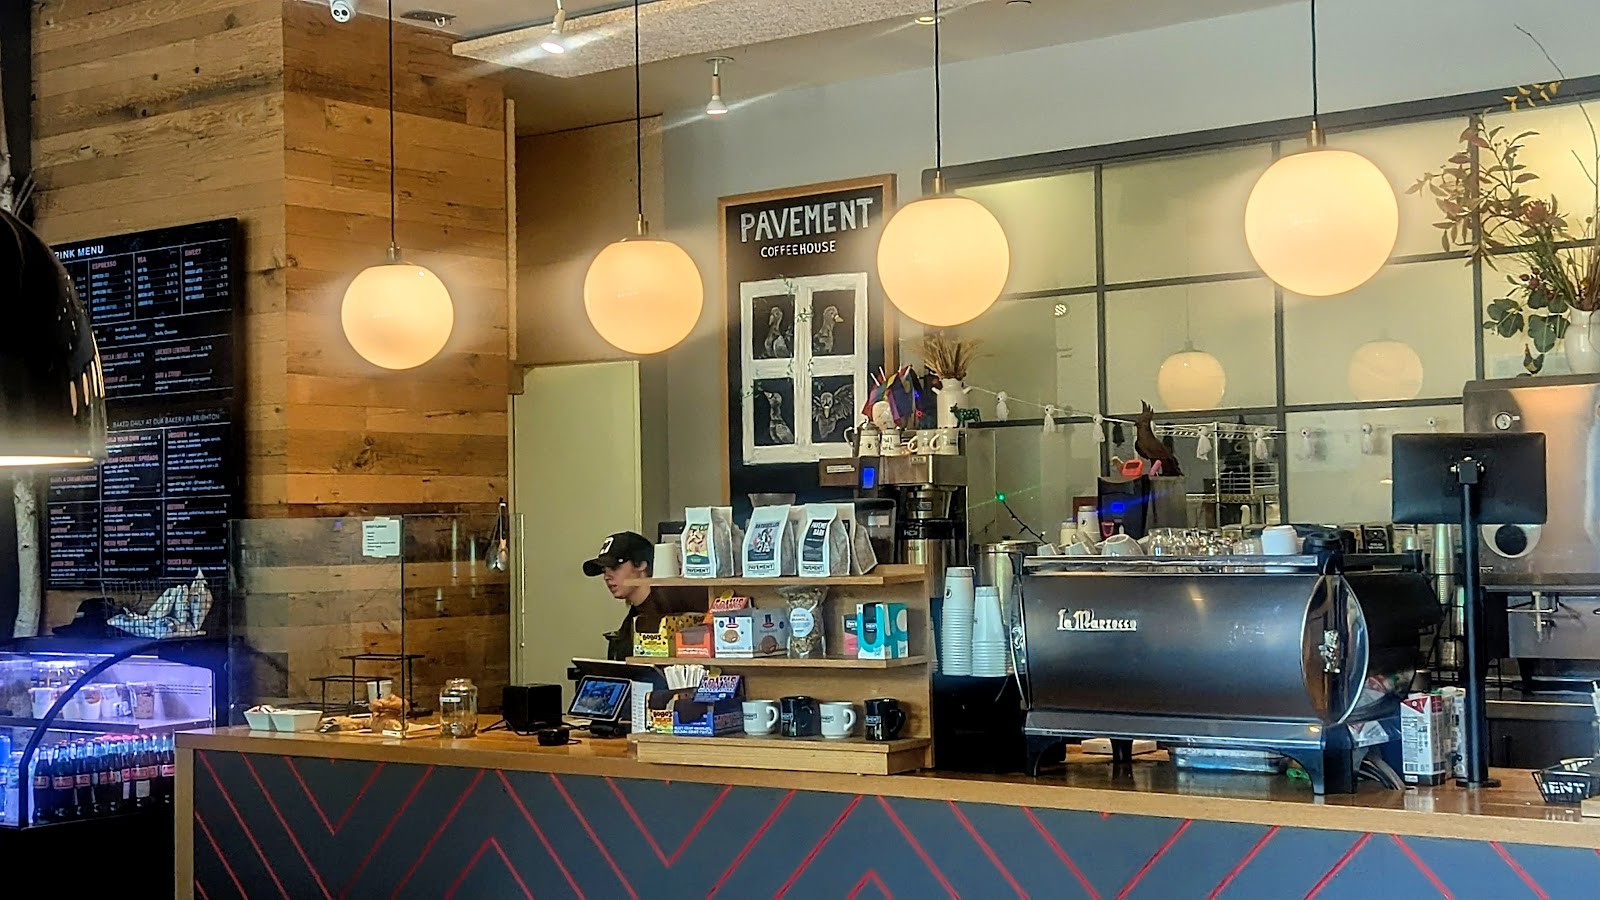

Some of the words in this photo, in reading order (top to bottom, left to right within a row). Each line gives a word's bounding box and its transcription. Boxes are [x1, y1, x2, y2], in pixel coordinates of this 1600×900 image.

[740, 197, 874, 243] PAVEMENT
[54, 249, 75, 260] RINK
[77, 244, 104, 257] MENU
[760, 240, 836, 258] COFFEEHOUSE
[92, 261, 117, 270] ESPRESSO
[112, 420, 130, 428] BAKED
[130, 419, 145, 427] DAILY
[164, 416, 185, 424] BAKERY
[1072, 608, 1137, 632] Marzocco
[653, 710, 673, 718] BOBO'S
